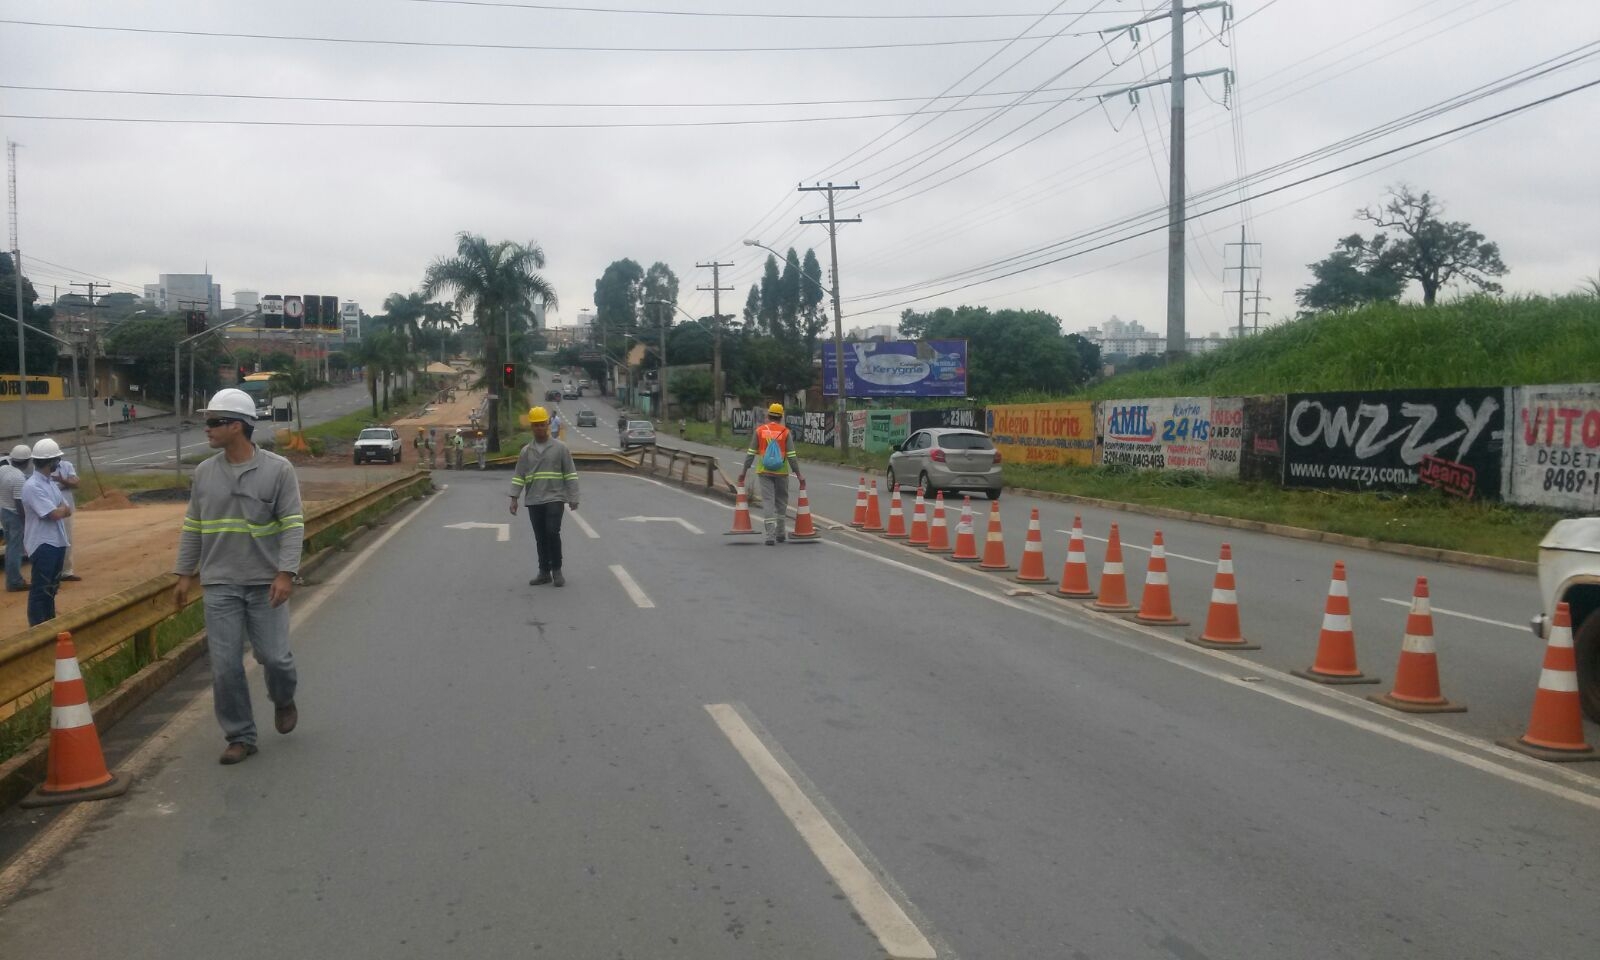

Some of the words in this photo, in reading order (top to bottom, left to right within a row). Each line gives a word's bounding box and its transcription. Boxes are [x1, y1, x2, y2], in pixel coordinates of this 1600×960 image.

[1110, 405, 1153, 435] AMIL
[1162, 418, 1189, 441] 24
[1537, 449, 1600, 468] DEDET
[1423, 459, 1470, 489] Jeans
